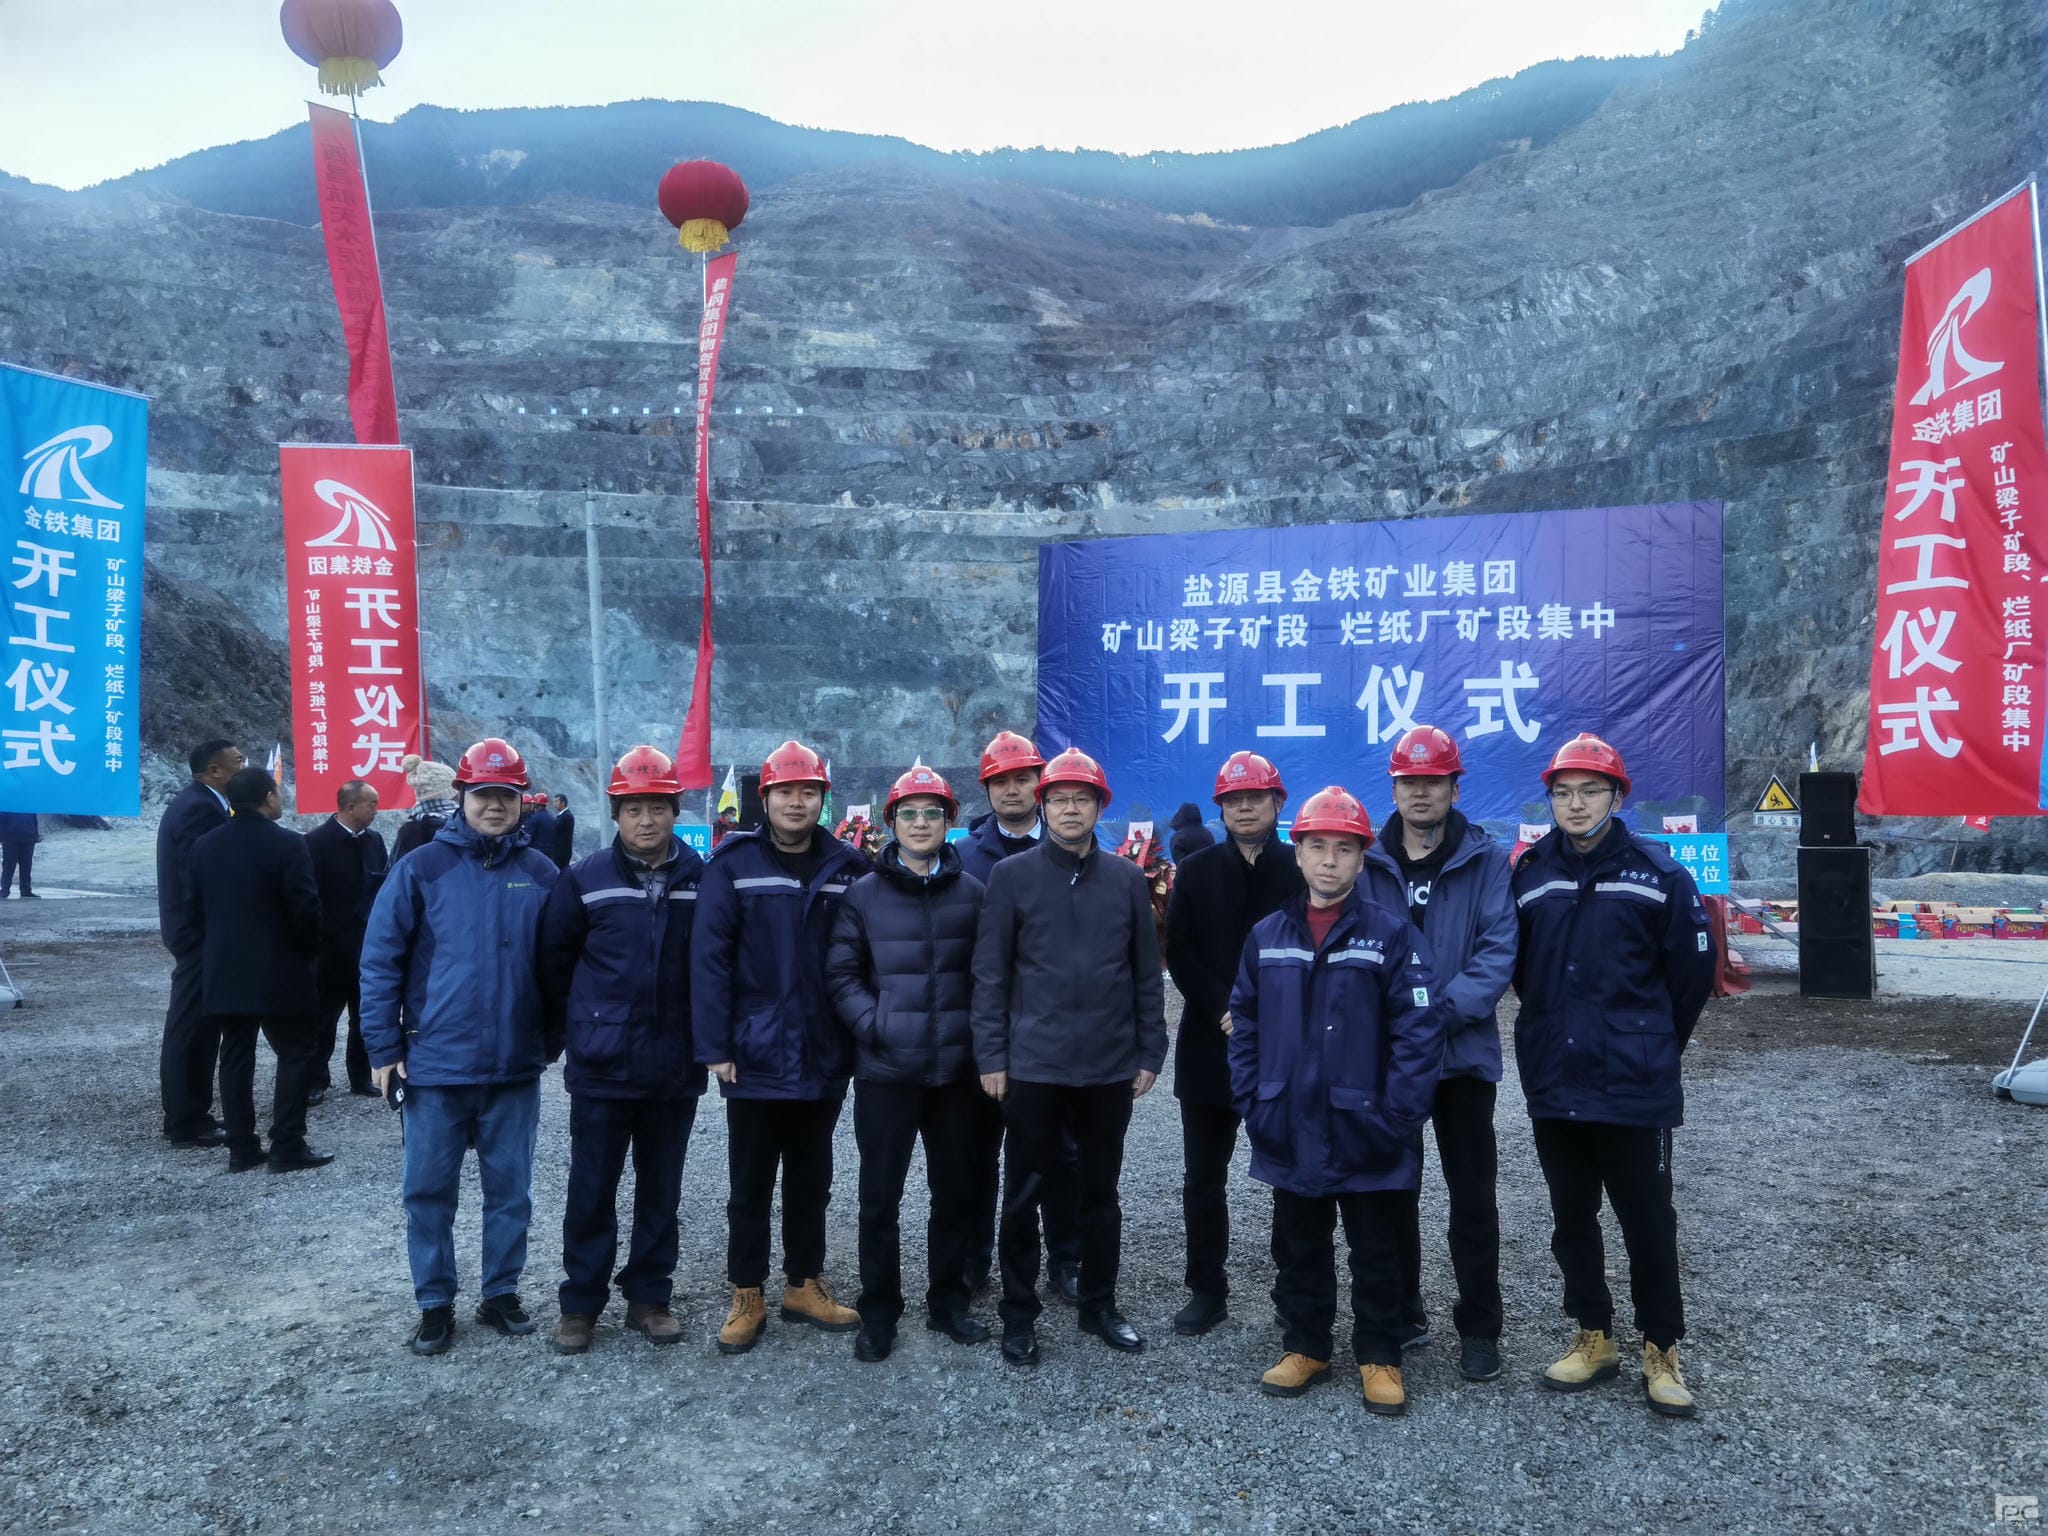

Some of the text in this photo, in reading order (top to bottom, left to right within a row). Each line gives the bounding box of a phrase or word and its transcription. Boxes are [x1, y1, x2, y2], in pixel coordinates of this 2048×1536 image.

[1912, 389, 2002, 444] 金铁集团
[24, 504, 120, 543] 金铁集团
[1182, 559, 1517, 608] 盐源县金铁矿业集团
[1878, 456, 1969, 758] 开工仪式
[1101, 602, 1616, 653] 矿山梁子矿段 烂纸厂矿段集中
[2, 540, 77, 776] 开工仪式
[1160, 660, 1542, 745] 开工仪式
